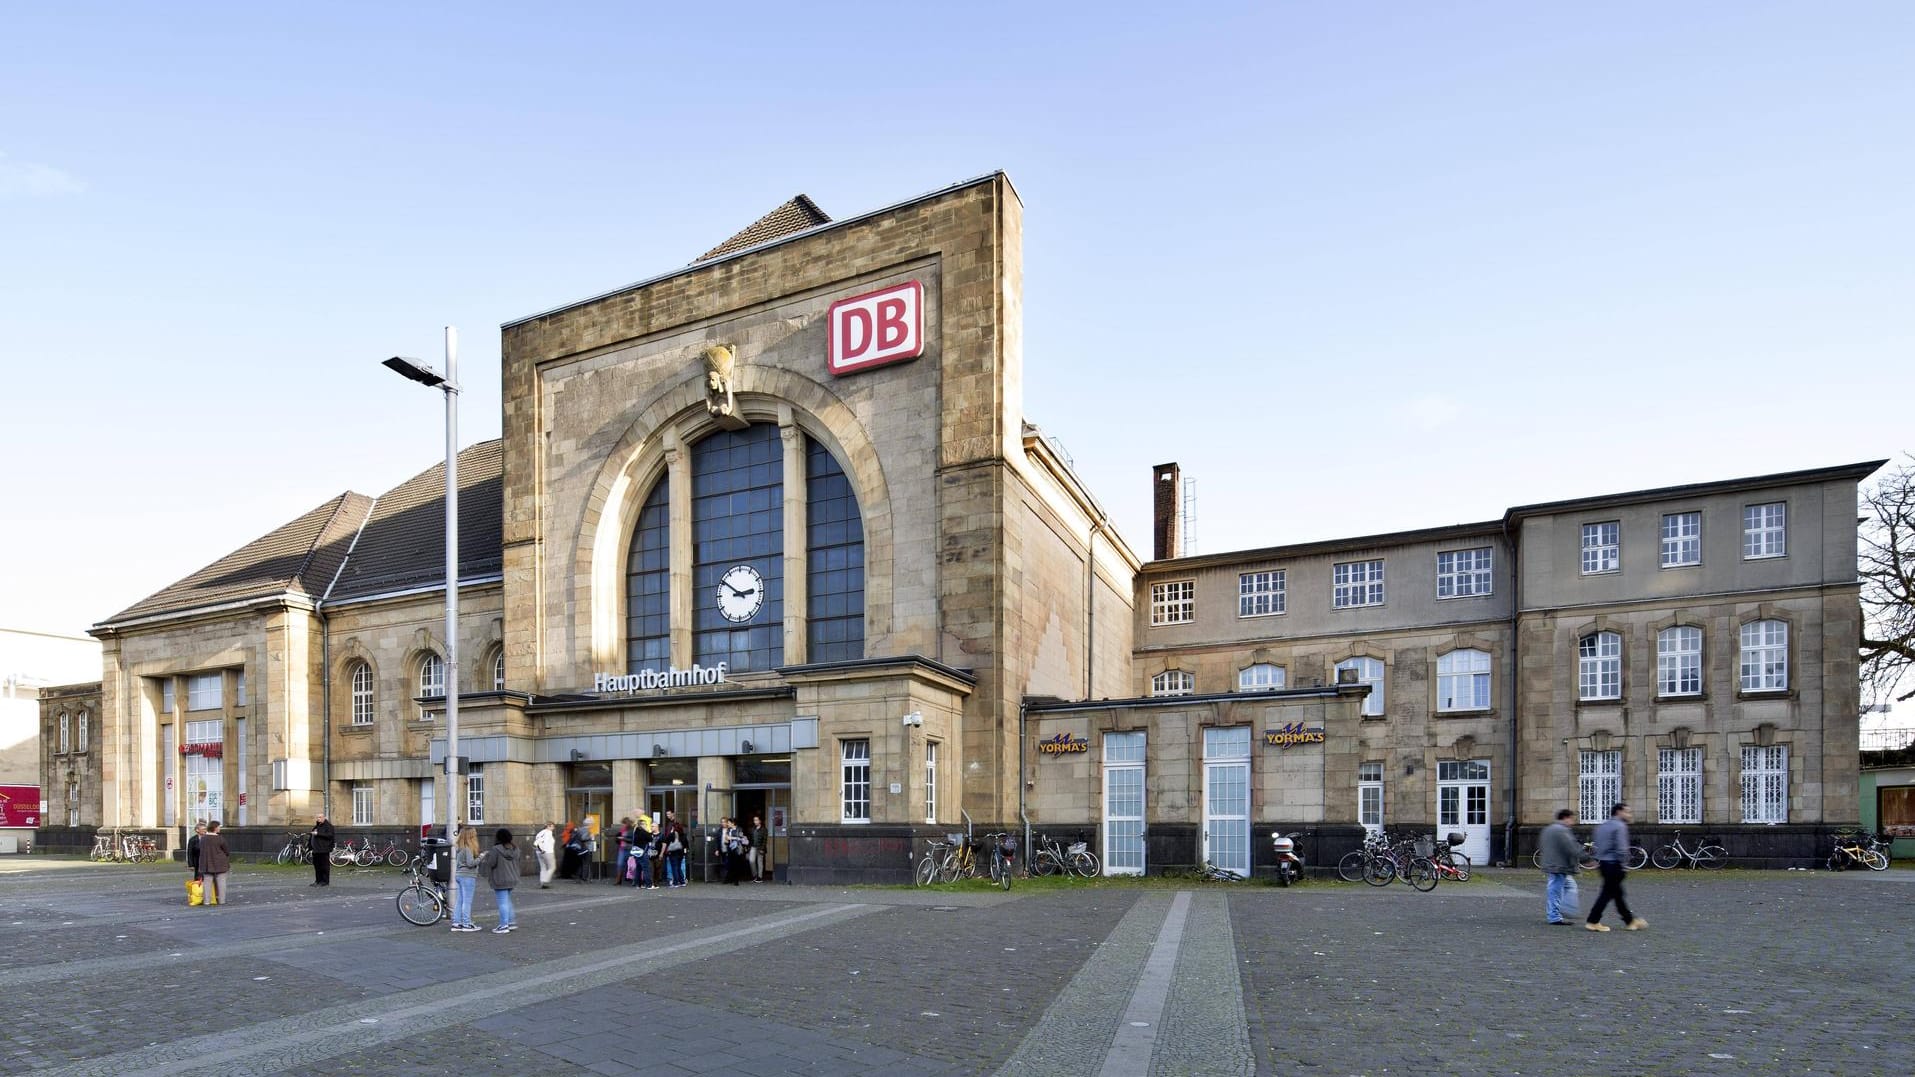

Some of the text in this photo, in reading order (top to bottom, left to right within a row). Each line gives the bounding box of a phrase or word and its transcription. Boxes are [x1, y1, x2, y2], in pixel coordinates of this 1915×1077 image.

[841, 297, 909, 361] DB
[594, 661, 727, 695] Hauptbahnhof
[1039, 742, 1088, 753] YORMA'S
[1266, 732, 1325, 744] YORMA'S
